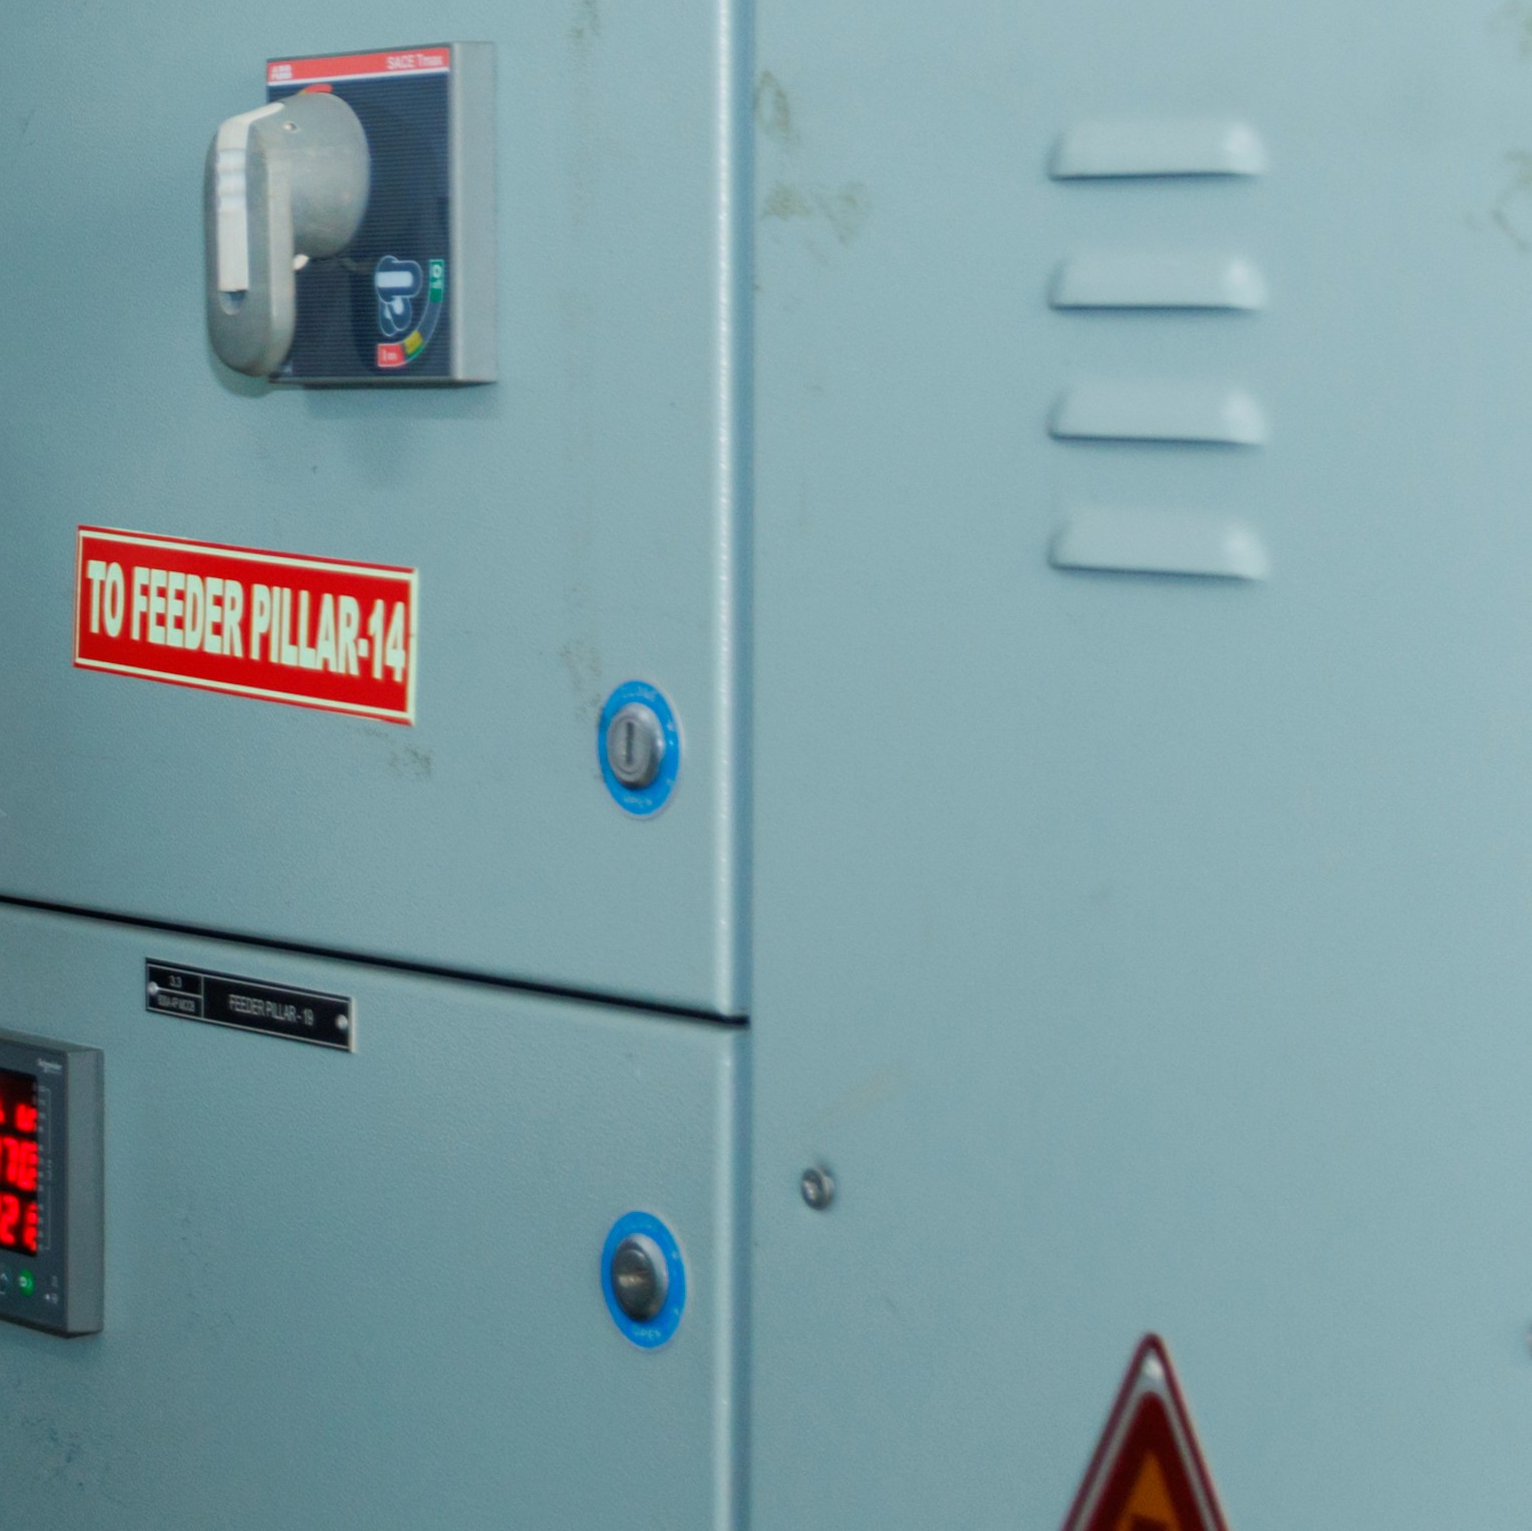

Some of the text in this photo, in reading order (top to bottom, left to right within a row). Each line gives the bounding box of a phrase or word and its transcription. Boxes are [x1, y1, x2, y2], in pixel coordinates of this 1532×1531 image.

[386, 55, 416, 70] SACE
[87, 559, 406, 684] TO FEEDER PILLAR-14
[228, 993, 265, 1016] FEEDER
